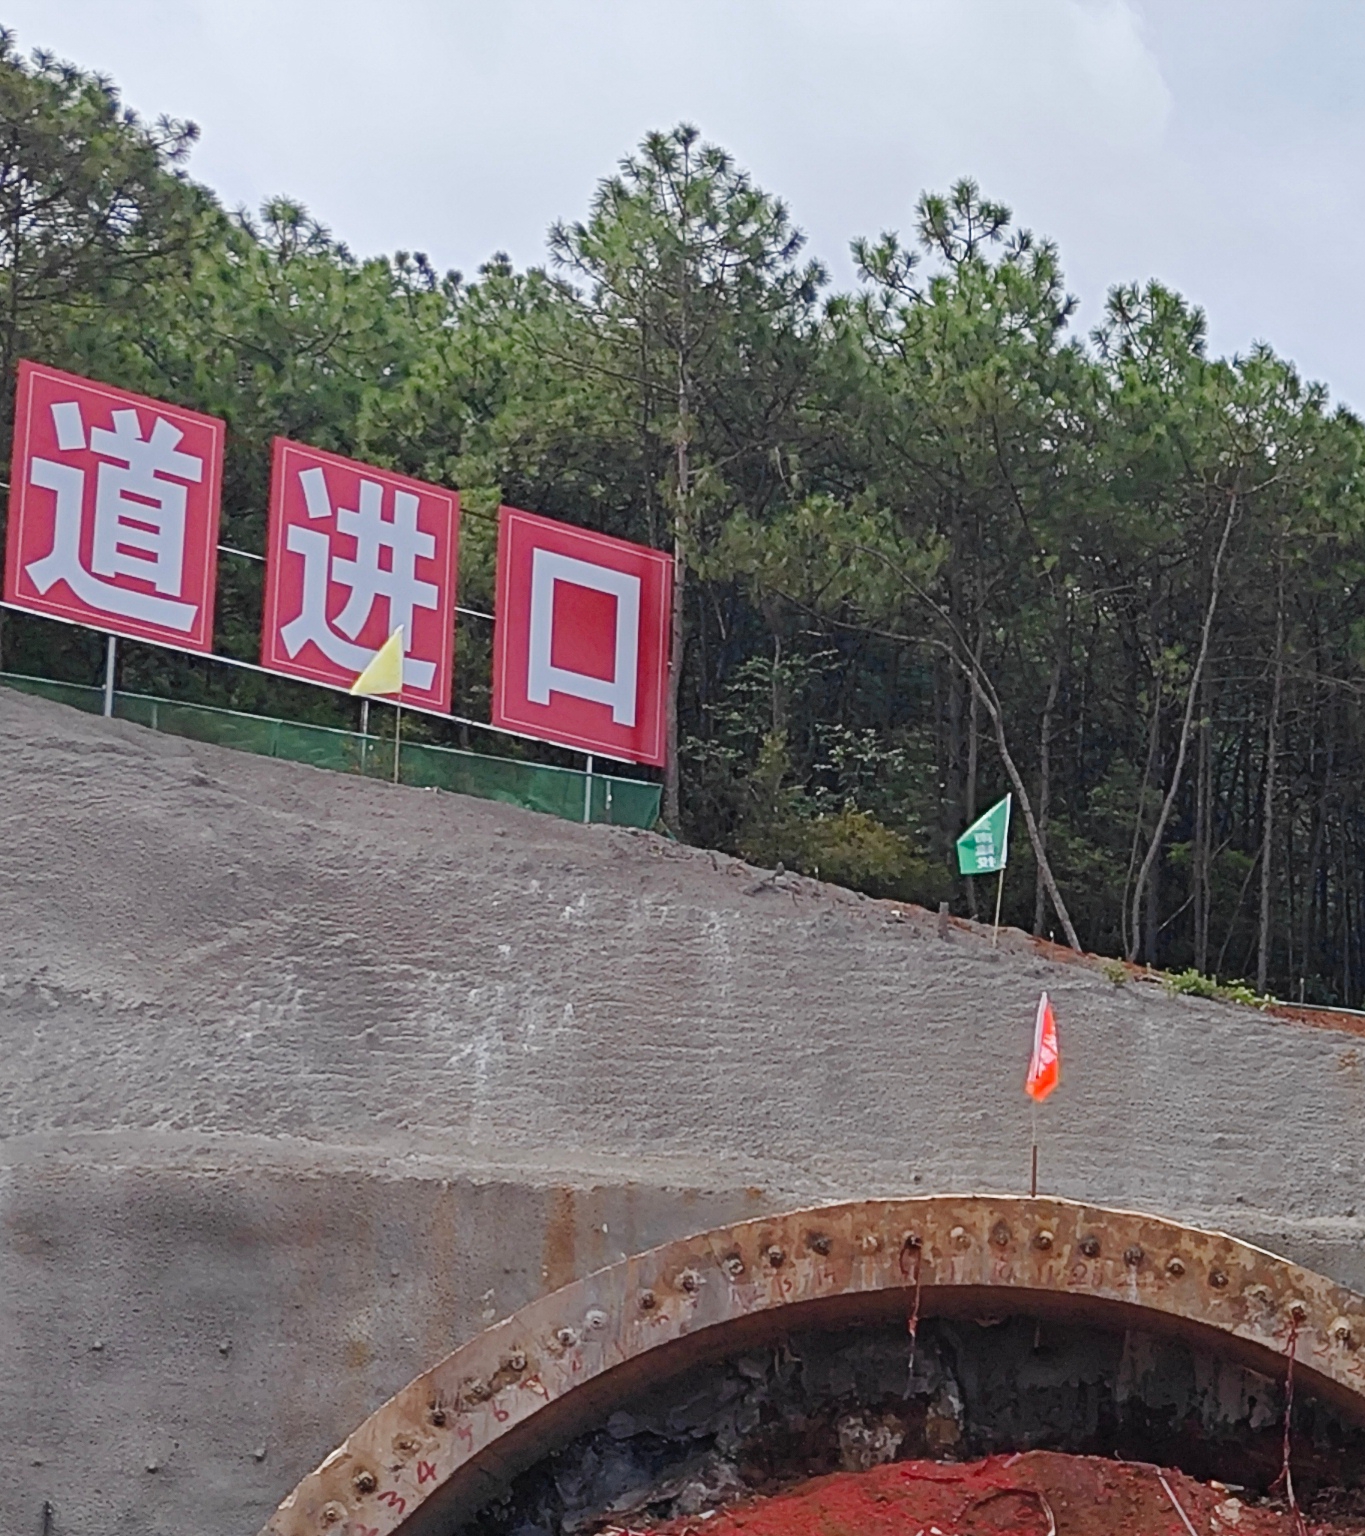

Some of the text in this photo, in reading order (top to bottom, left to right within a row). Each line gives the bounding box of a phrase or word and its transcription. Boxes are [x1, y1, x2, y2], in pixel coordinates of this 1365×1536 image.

[25, 401, 641, 728] 道进口
[377, 1490, 406, 1516] 3
